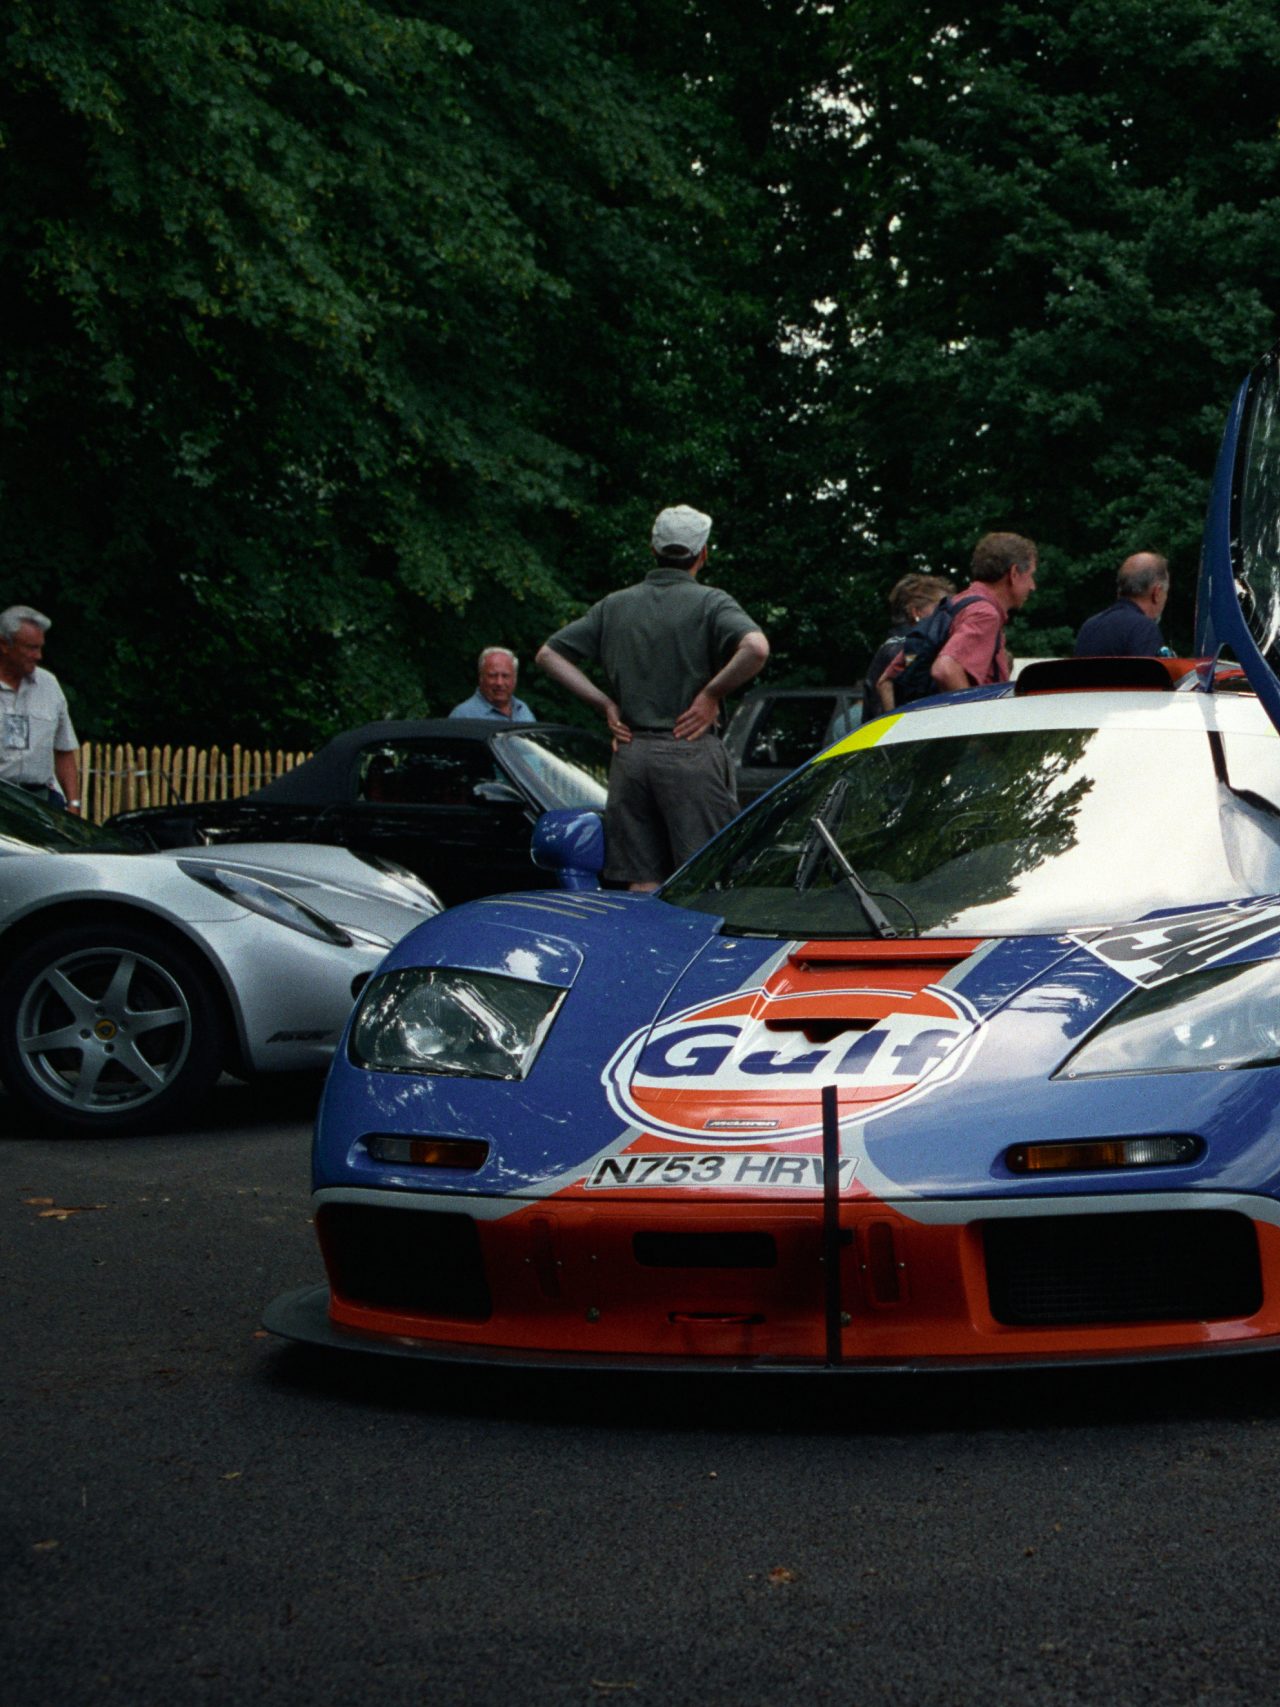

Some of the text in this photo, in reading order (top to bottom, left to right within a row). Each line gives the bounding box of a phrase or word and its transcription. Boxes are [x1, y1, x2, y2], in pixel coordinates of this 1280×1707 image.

[635, 1023, 962, 1078] Gulf
[594, 1156, 852, 1184] N753 HRV
